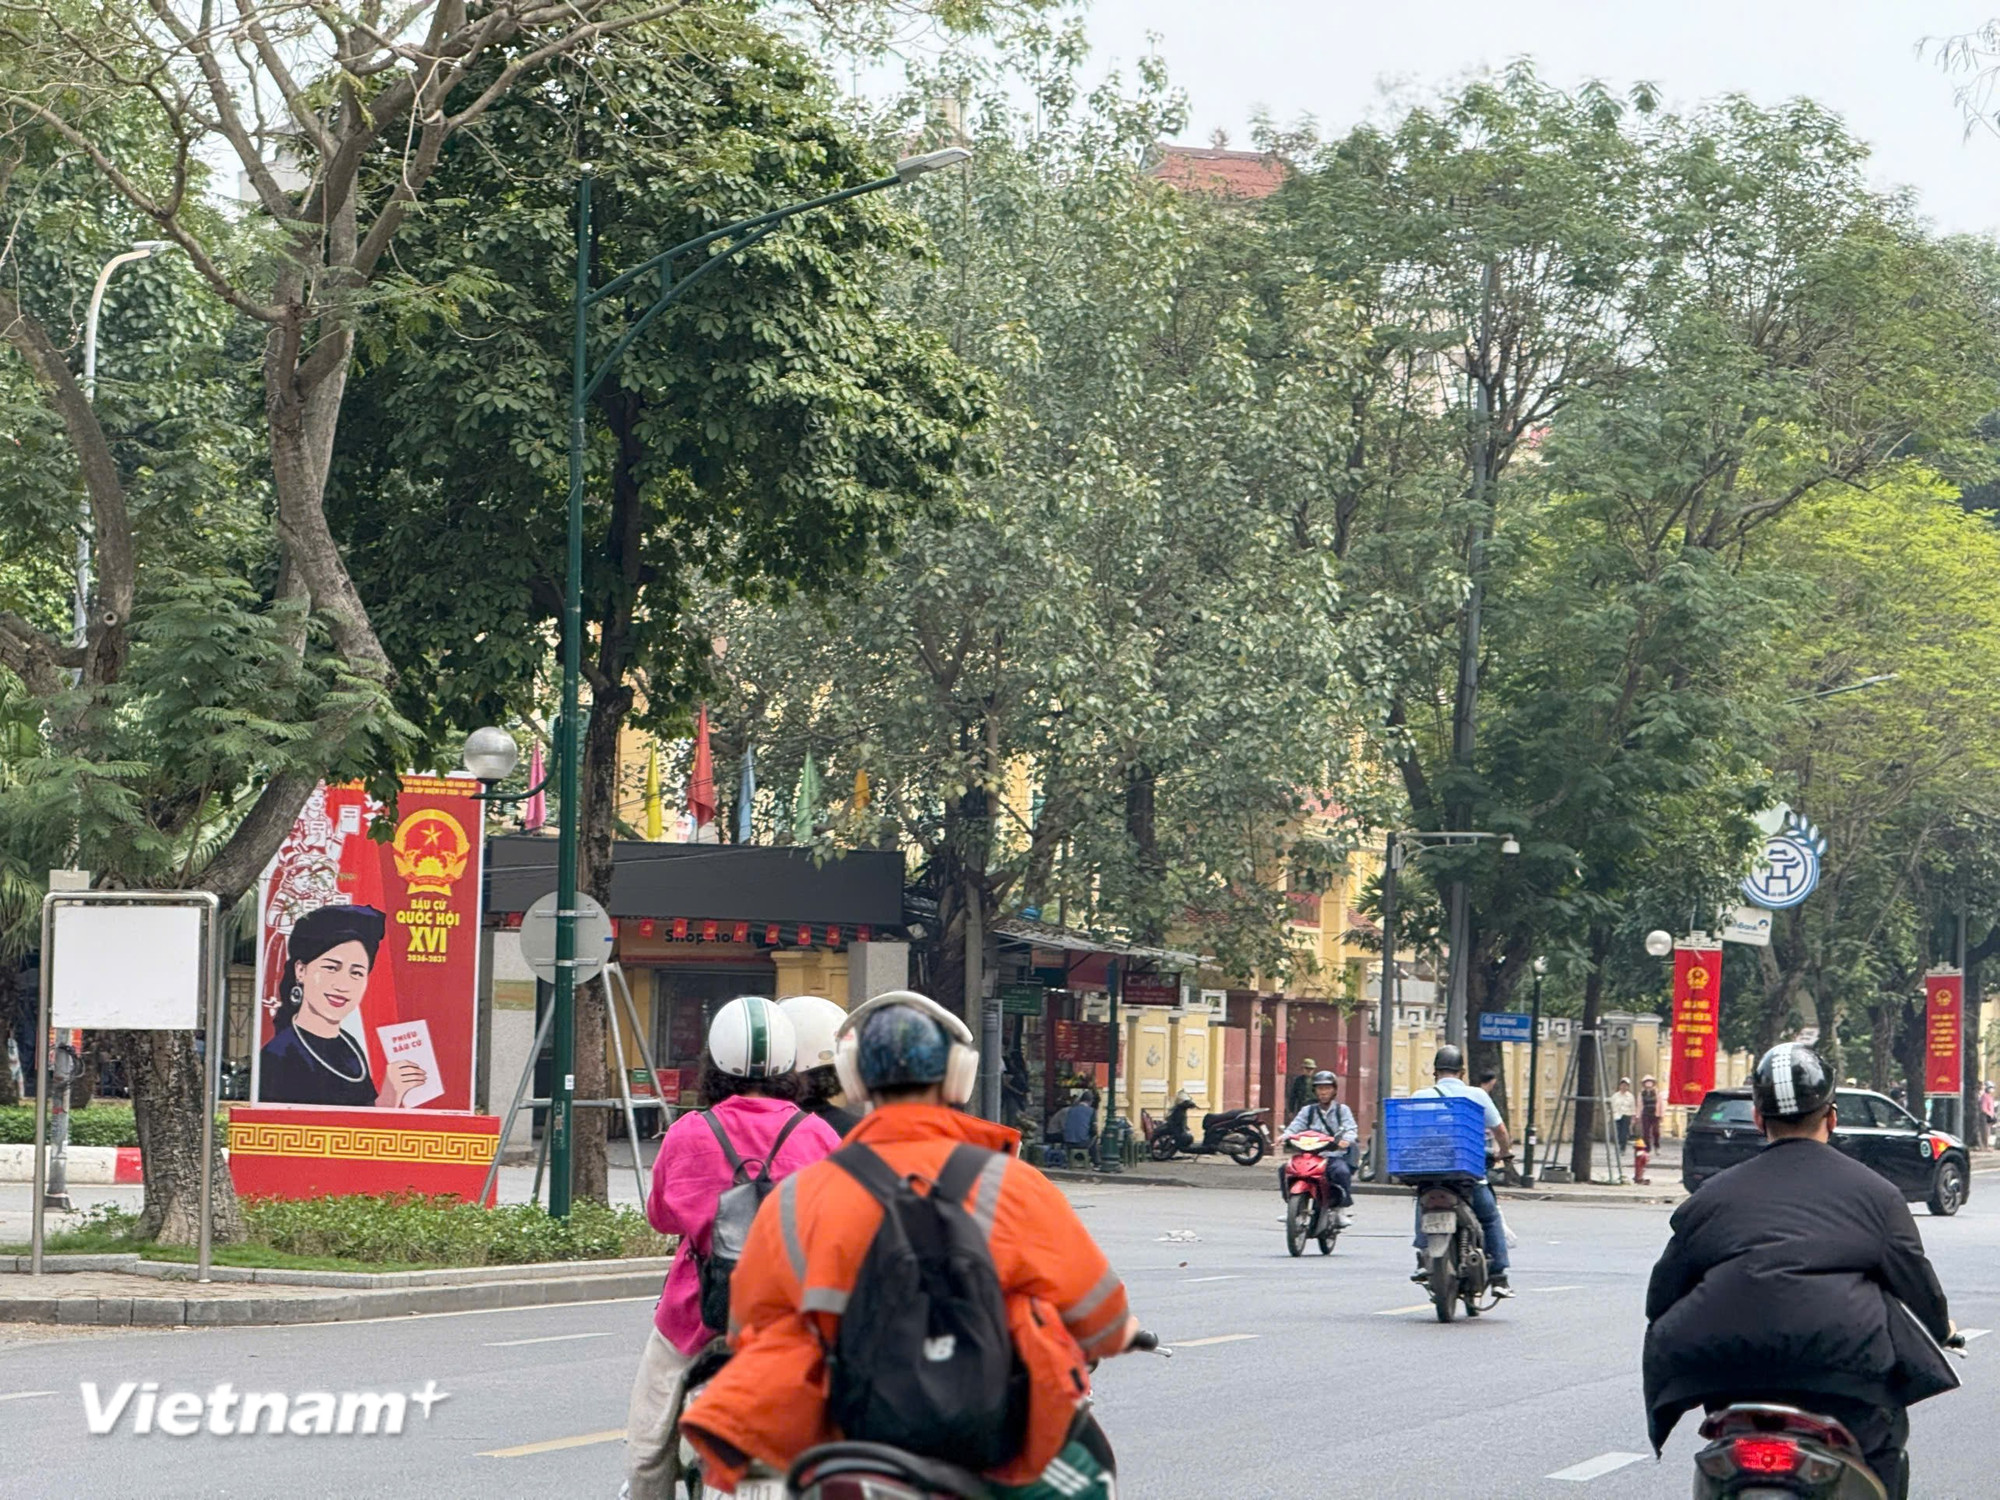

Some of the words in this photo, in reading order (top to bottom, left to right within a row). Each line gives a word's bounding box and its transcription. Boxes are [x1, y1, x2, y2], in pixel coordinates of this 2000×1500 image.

[395, 909, 433, 925] QUỐC
[435, 910, 460, 928] HỘI
[407, 925, 447, 953] XVI
